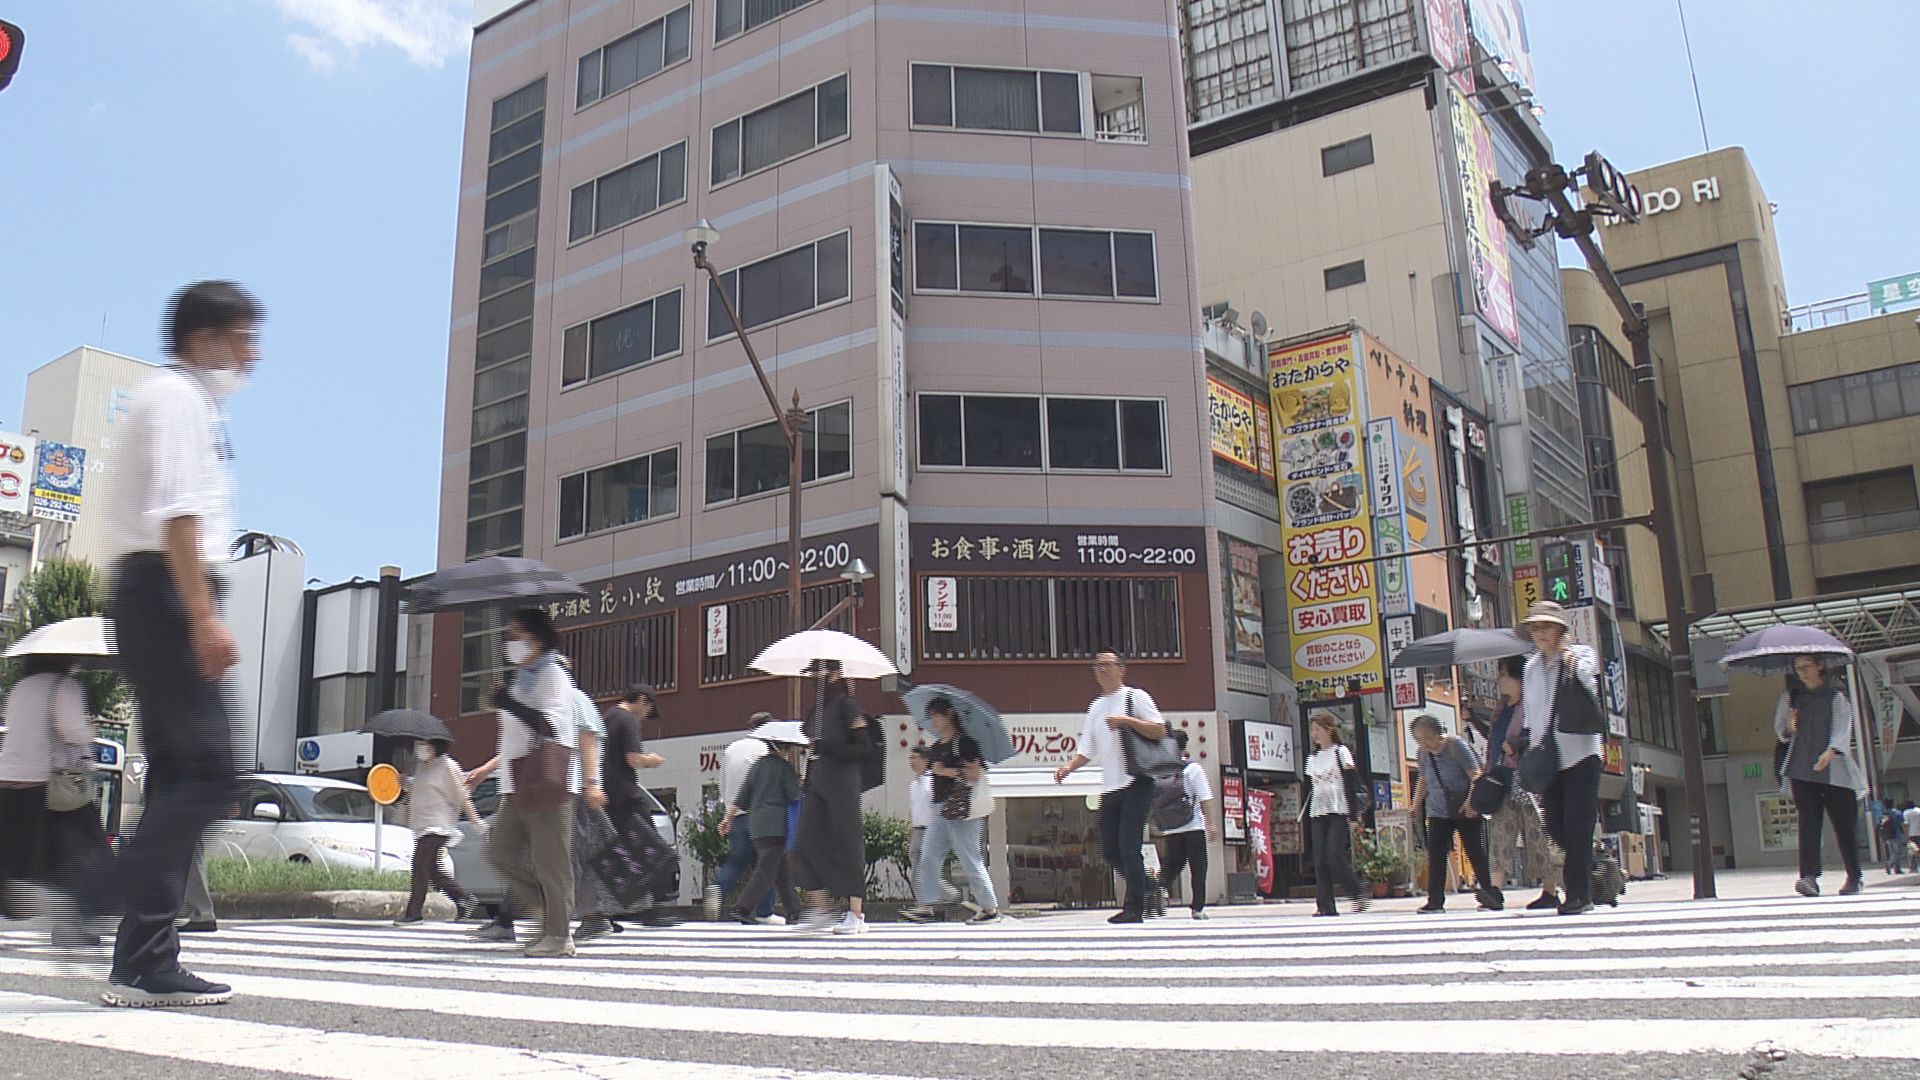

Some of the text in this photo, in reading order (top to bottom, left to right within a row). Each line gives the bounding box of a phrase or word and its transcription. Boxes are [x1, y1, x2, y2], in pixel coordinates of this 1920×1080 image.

[1272, 357, 1350, 388] おたからや
[1208, 392, 1251, 433] たからや
[931, 536, 1060, 561] お食事・酒処
[1077, 535, 1119, 546] 営業時間
[1077, 548, 1196, 564] 11:00～22:00
[1288, 526, 1366, 566] お売り
[540, 576, 664, 620] 事・酒処 花小紋
[936, 579, 949, 611] ランチ
[1290, 563, 1369, 602] ください
[713, 608, 722, 639] ランチ
[1298, 603, 1366, 629] 安心買取
[1306, 639, 1361, 655] 買取のことなら
[1012, 733, 1077, 753] りんごの
[1248, 796, 1270, 878] 営業中
